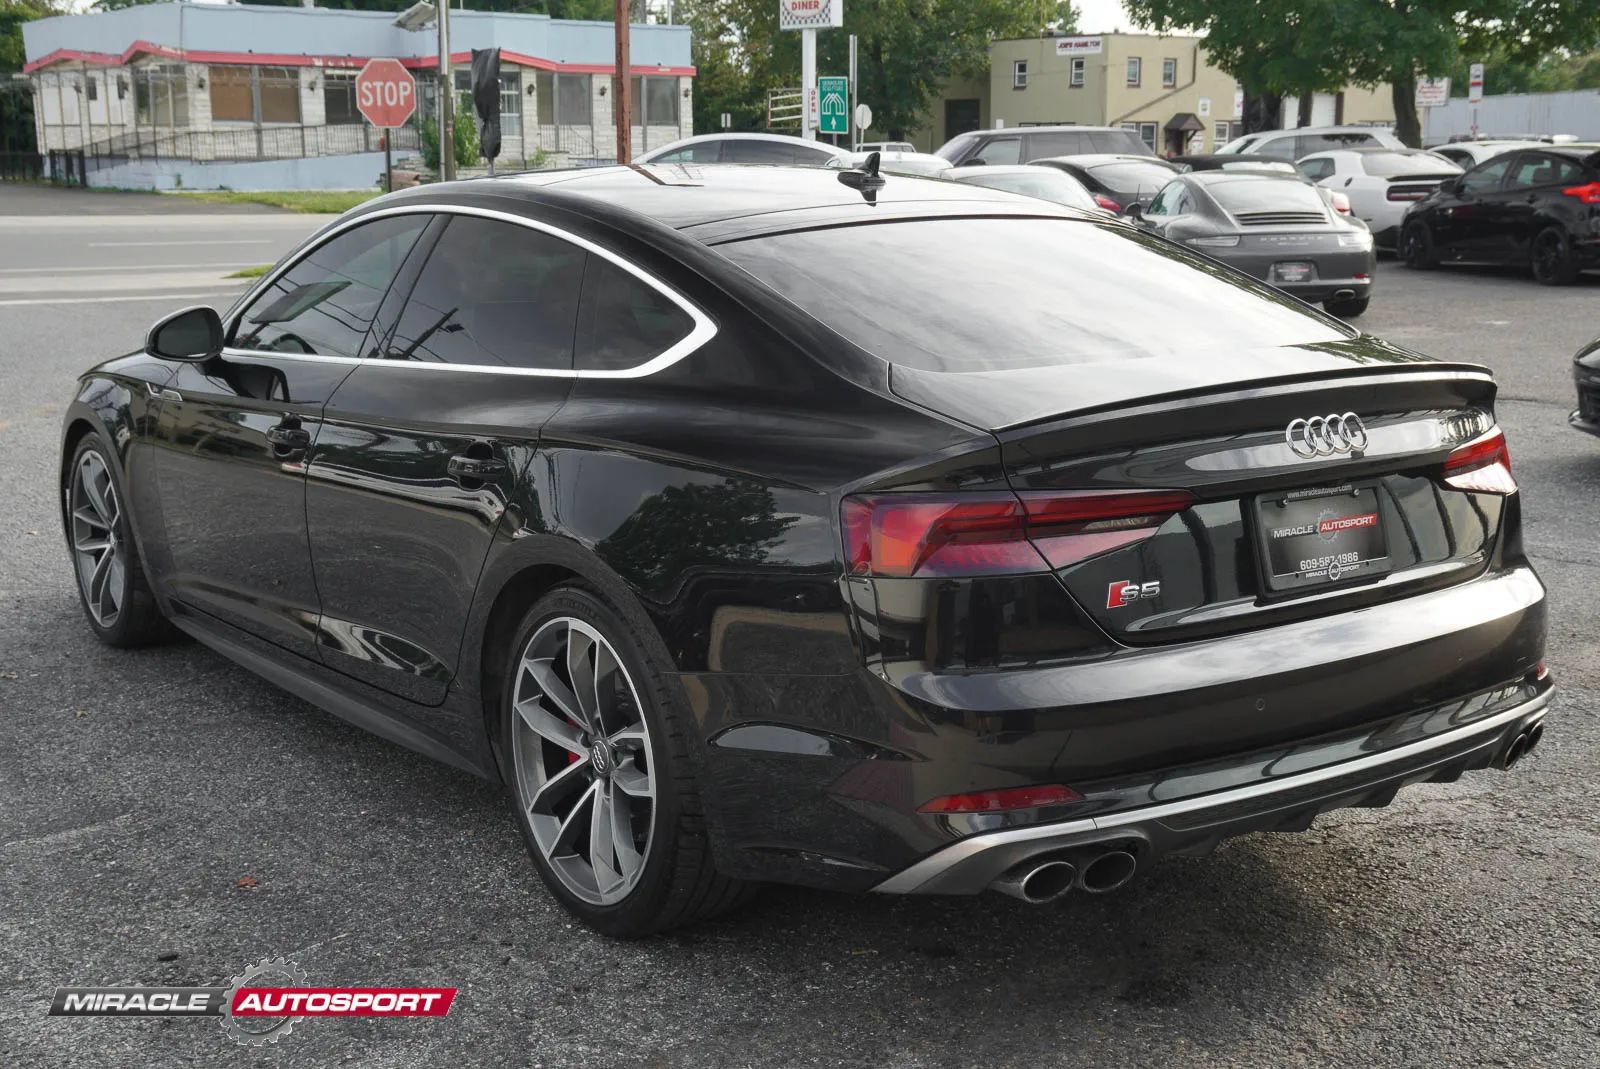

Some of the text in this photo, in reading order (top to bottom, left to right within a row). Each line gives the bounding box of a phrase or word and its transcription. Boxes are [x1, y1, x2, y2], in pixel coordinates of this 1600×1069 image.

[791, 1, 820, 11] DINER
[361, 80, 412, 107] STOP
[1273, 515, 1374, 539] MIRACLE AUTOSPORT
[1300, 551, 1359, 571] 609-587-1986
